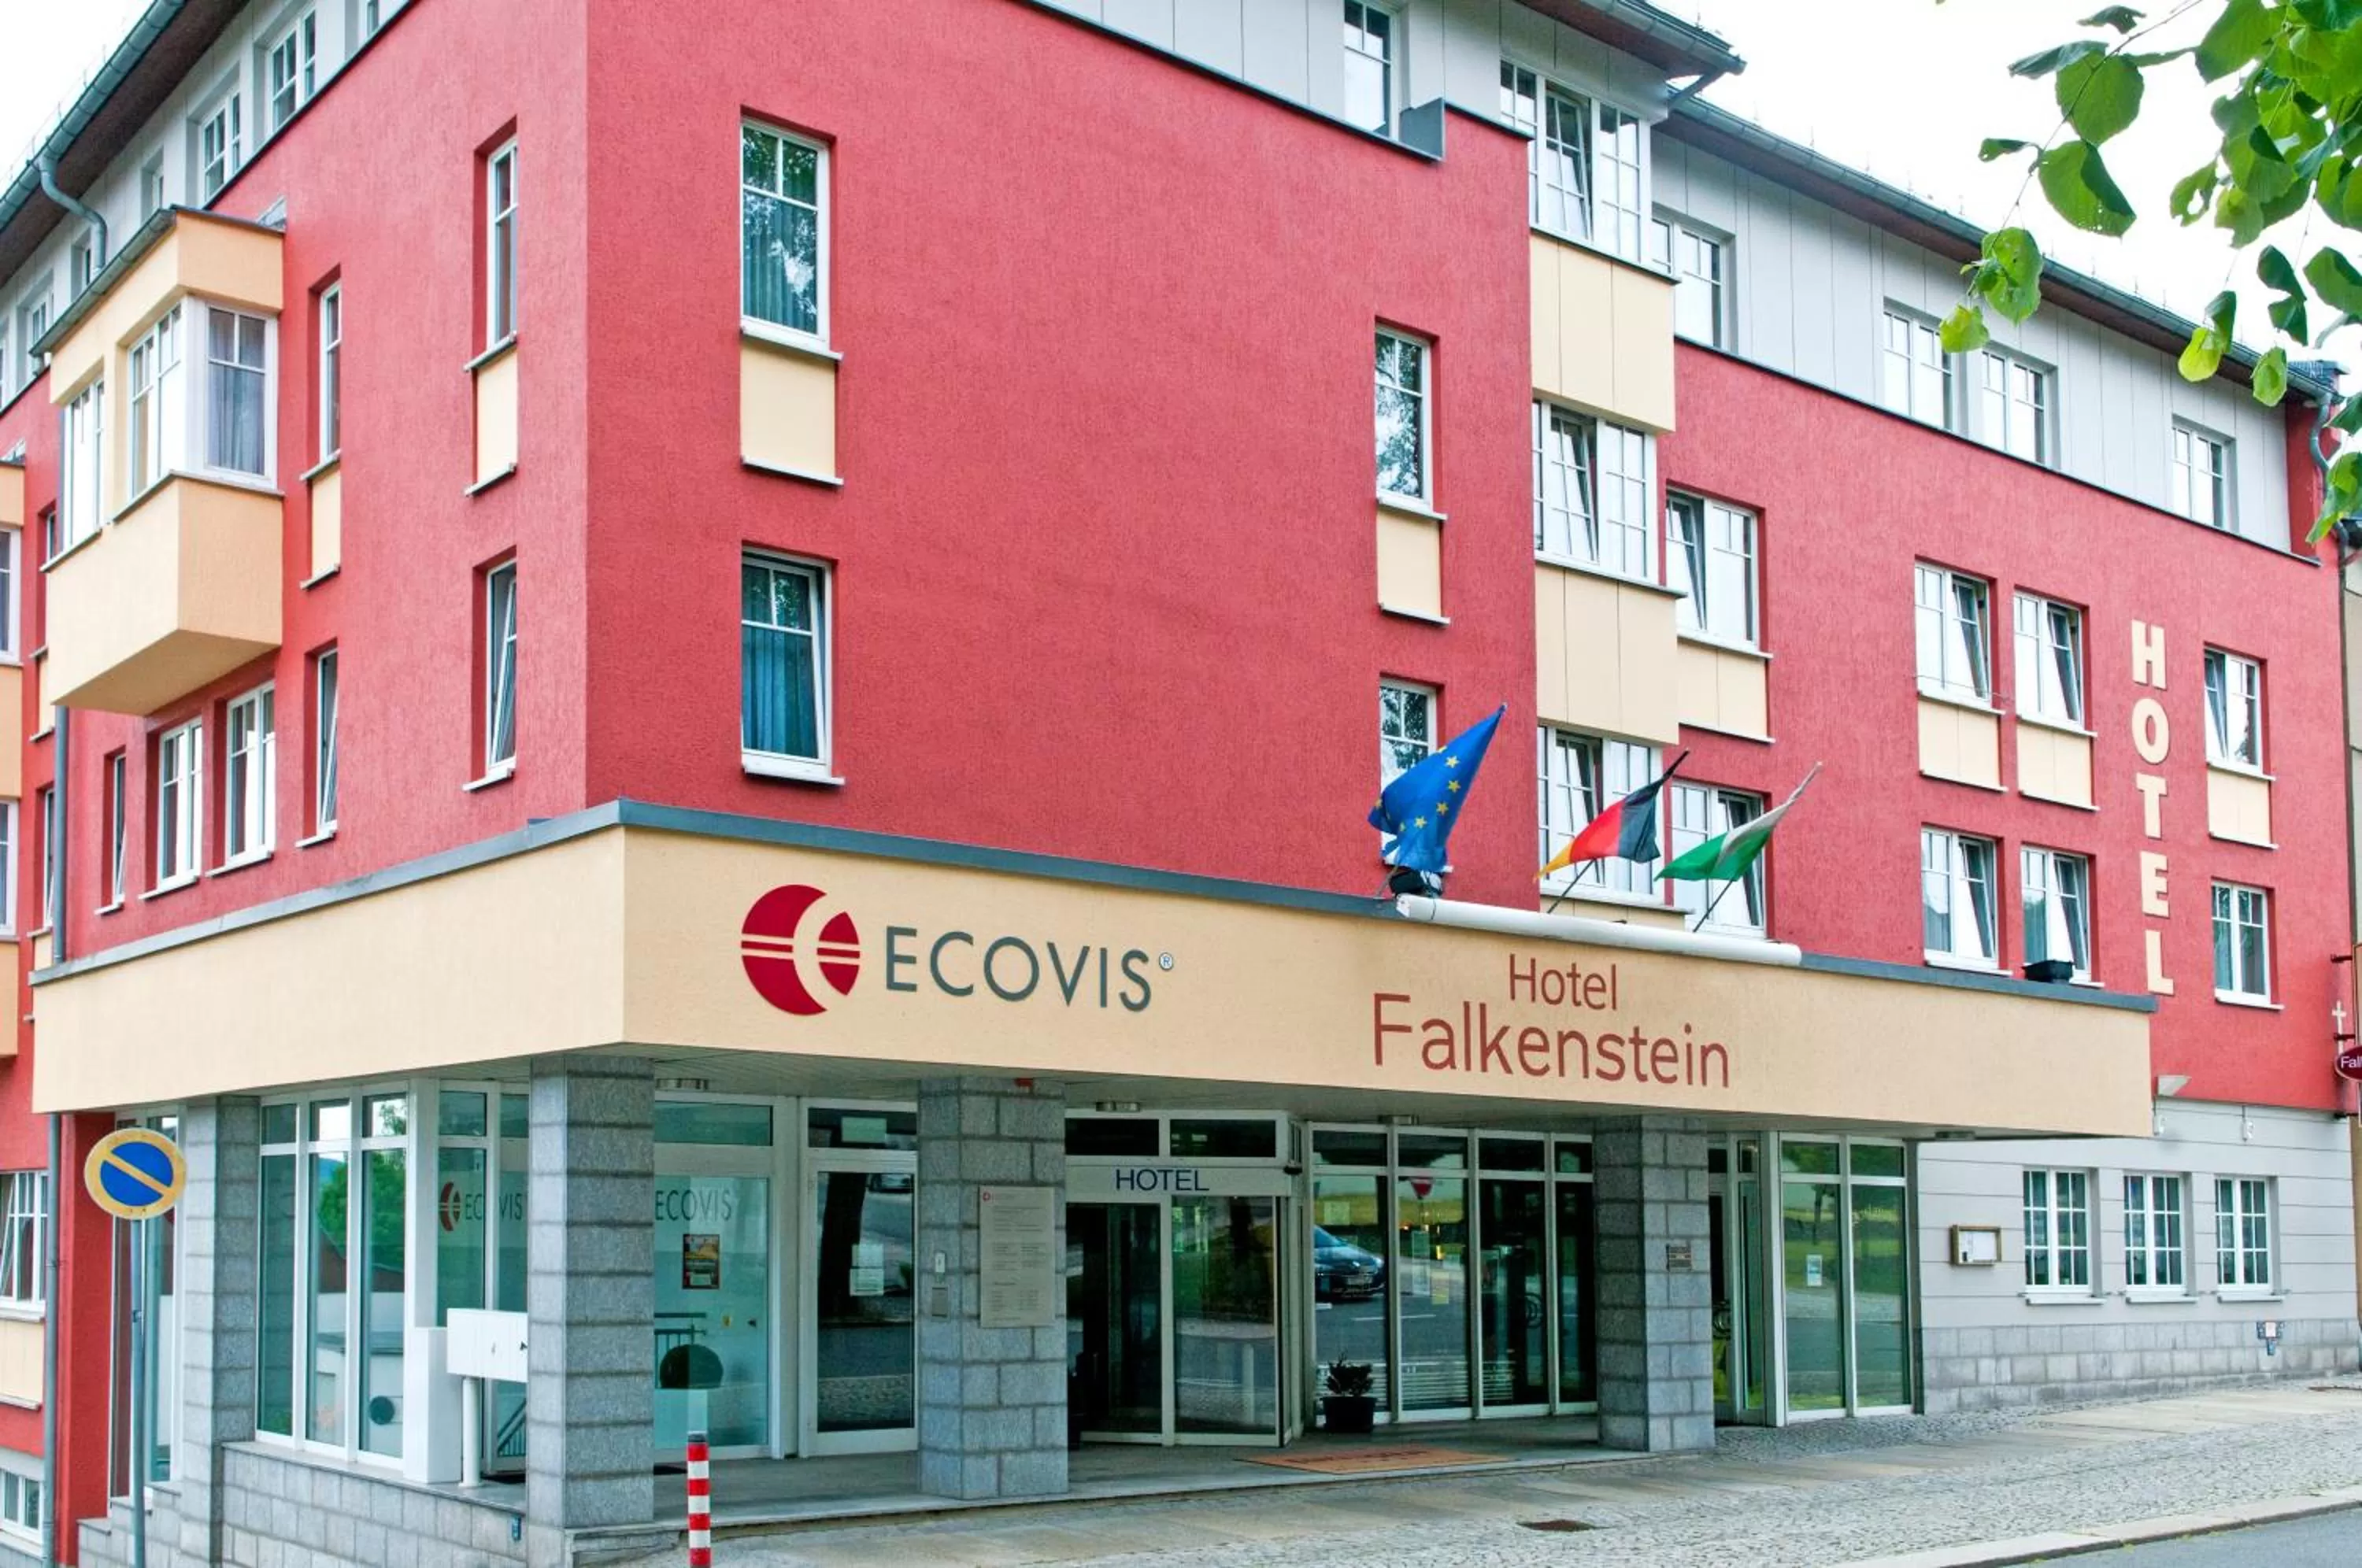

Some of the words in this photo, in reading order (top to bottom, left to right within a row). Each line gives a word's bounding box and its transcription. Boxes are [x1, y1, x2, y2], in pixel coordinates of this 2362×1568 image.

[2131, 618, 2175, 996] HOTEL
[1509, 952, 1618, 1011] Hotel
[1373, 992, 1730, 1089] Falkenstein
[2341, 1055, 2362, 1068] Fal
[1116, 1168, 1210, 1191] HOTEL
[465, 1193, 523, 1221] ECVIS
[655, 1189, 732, 1222] ECOVIS
